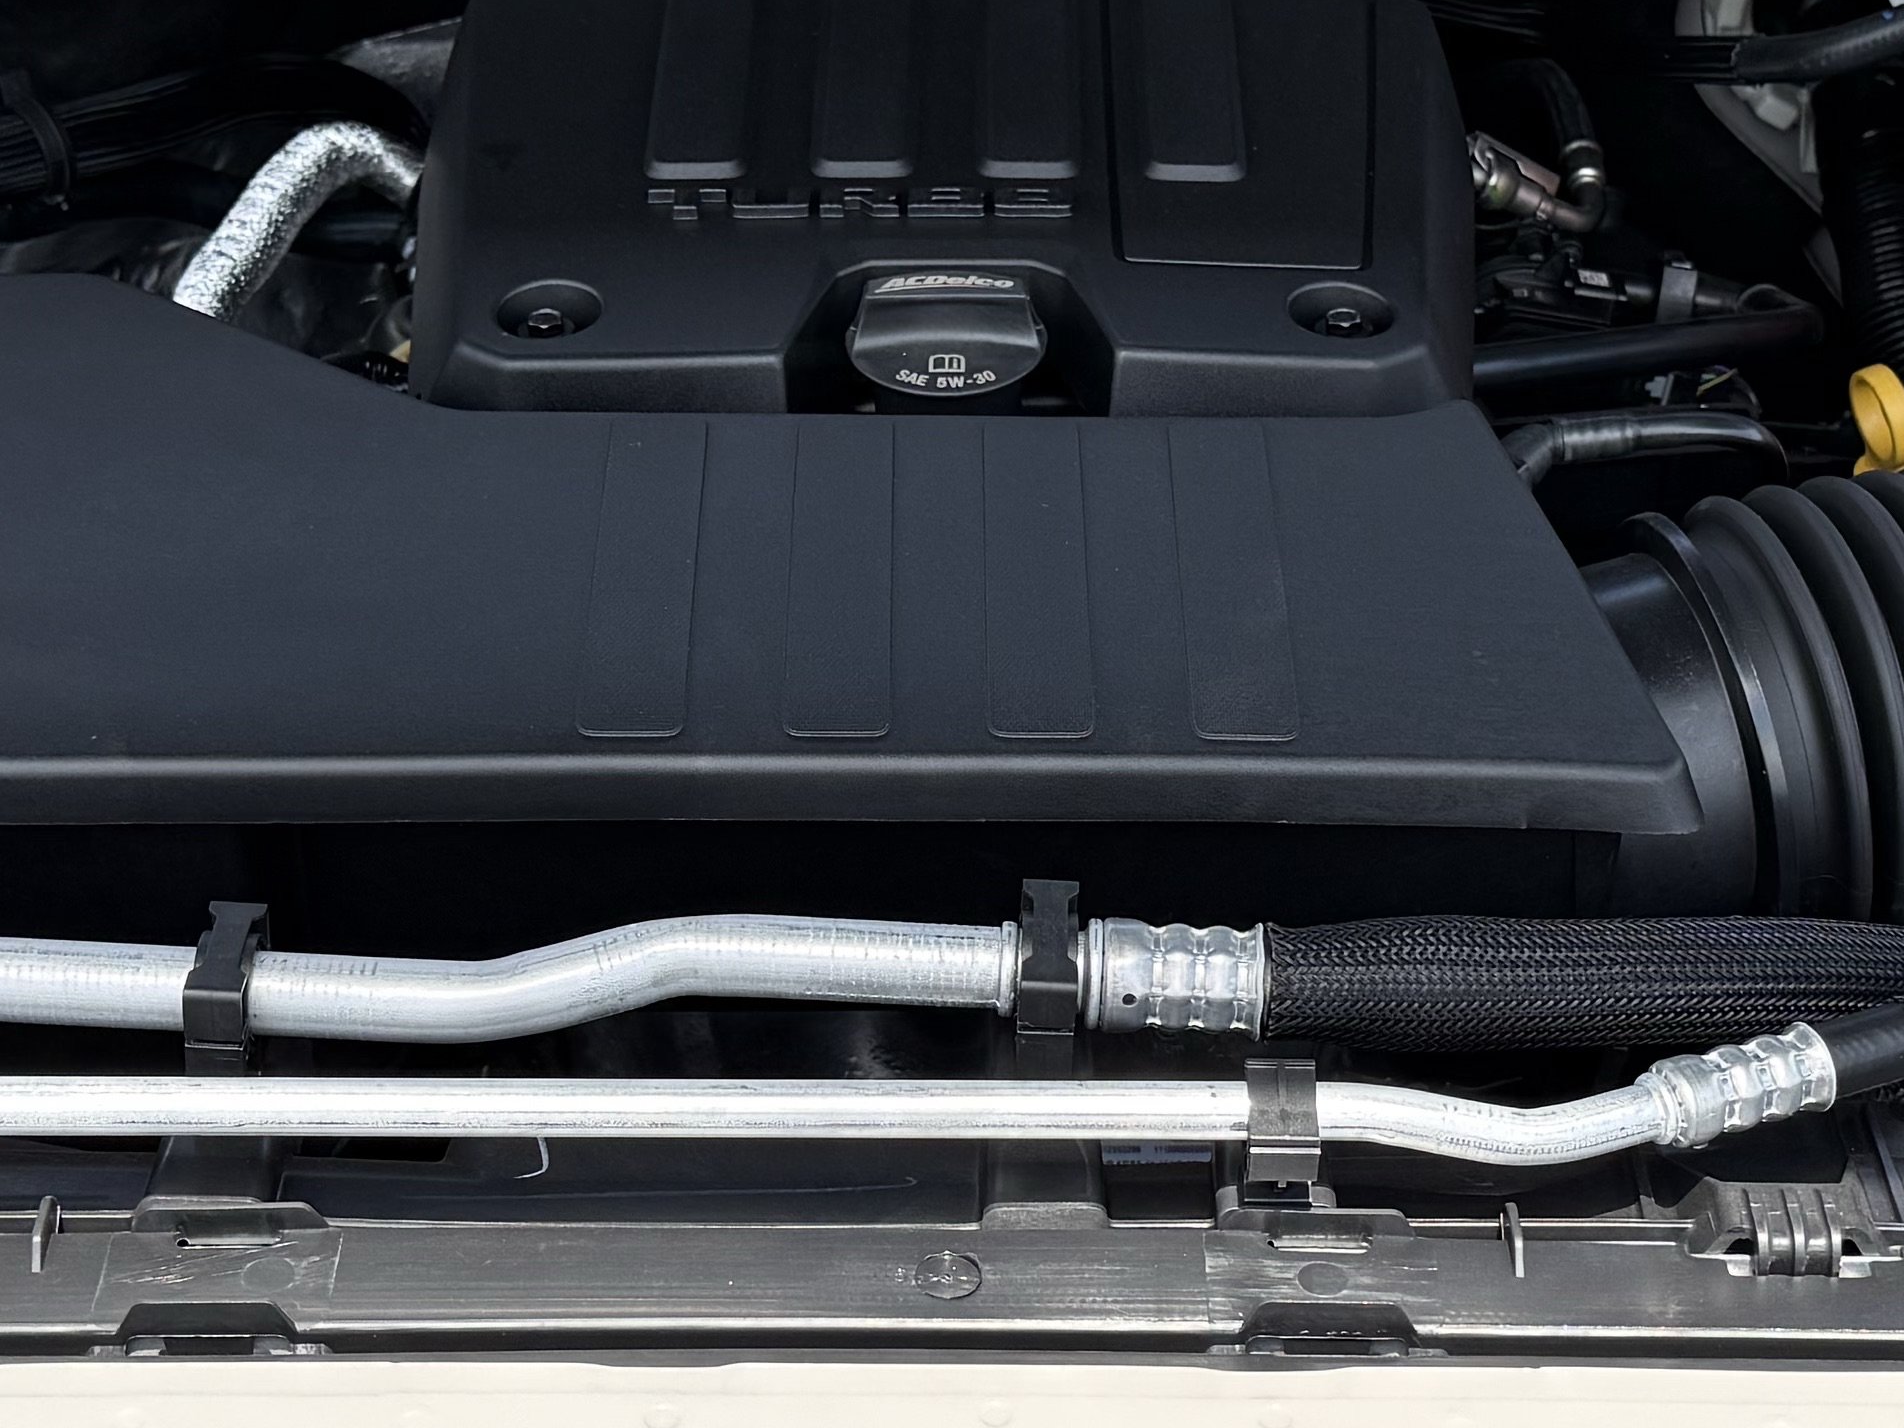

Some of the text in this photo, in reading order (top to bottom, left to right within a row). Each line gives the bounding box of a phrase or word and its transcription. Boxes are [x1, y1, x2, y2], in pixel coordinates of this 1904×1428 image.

[879, 275, 1015, 291] ACDelco
[895, 369, 997, 390] SAE 5W-30
